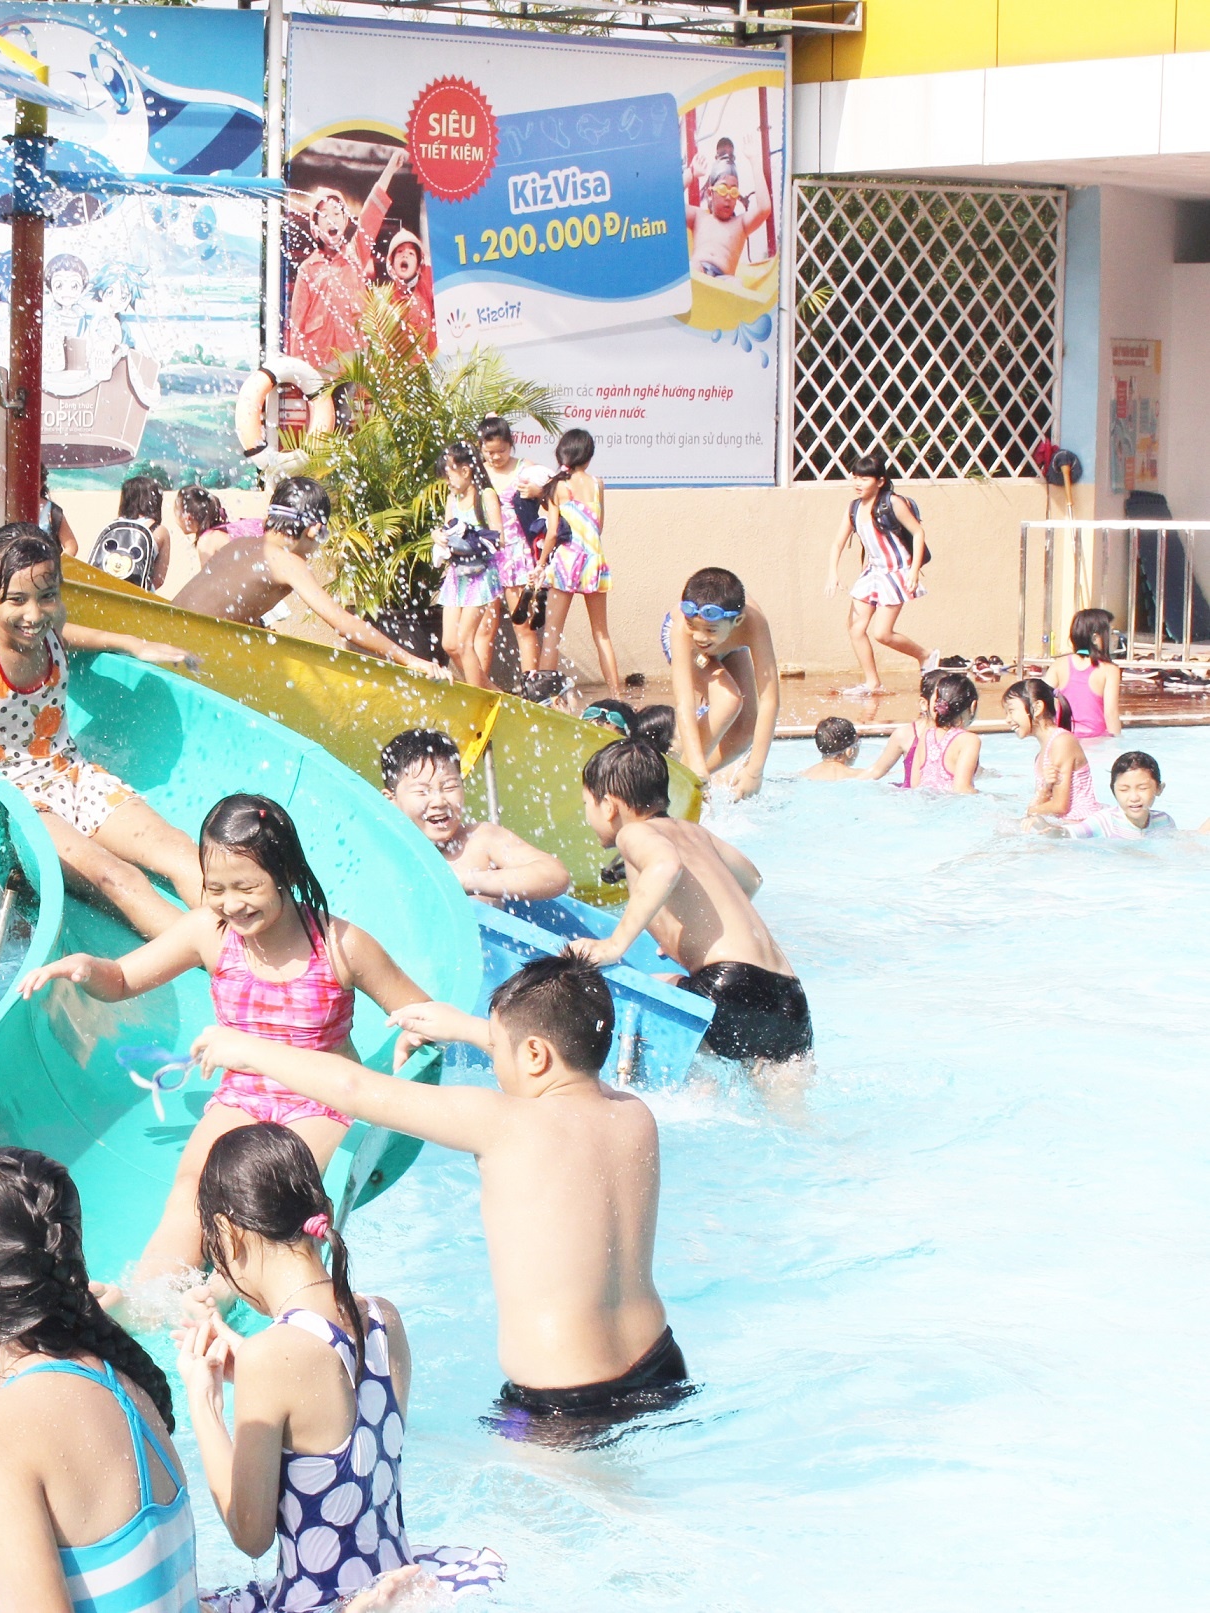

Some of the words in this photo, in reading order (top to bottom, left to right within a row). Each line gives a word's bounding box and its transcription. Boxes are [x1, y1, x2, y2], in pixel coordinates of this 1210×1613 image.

[428, 109, 476, 138] SIÊU
[419, 139, 448, 159] TIẾT
[451, 143, 484, 164] KIỆM
[511, 170, 608, 210] KizVisa
[596, 384, 631, 400] ngành
[633, 384, 660, 401] nghề
[698, 385, 734, 402] nghiệp
[564, 405, 591, 421] Công
[594, 406, 617, 419] viên
[521, 432, 541, 448] hạn
[606, 433, 623, 448] gia
[625, 434, 653, 448] trong
[678, 433, 700, 448] gian
[716, 433, 743, 449] dụng
